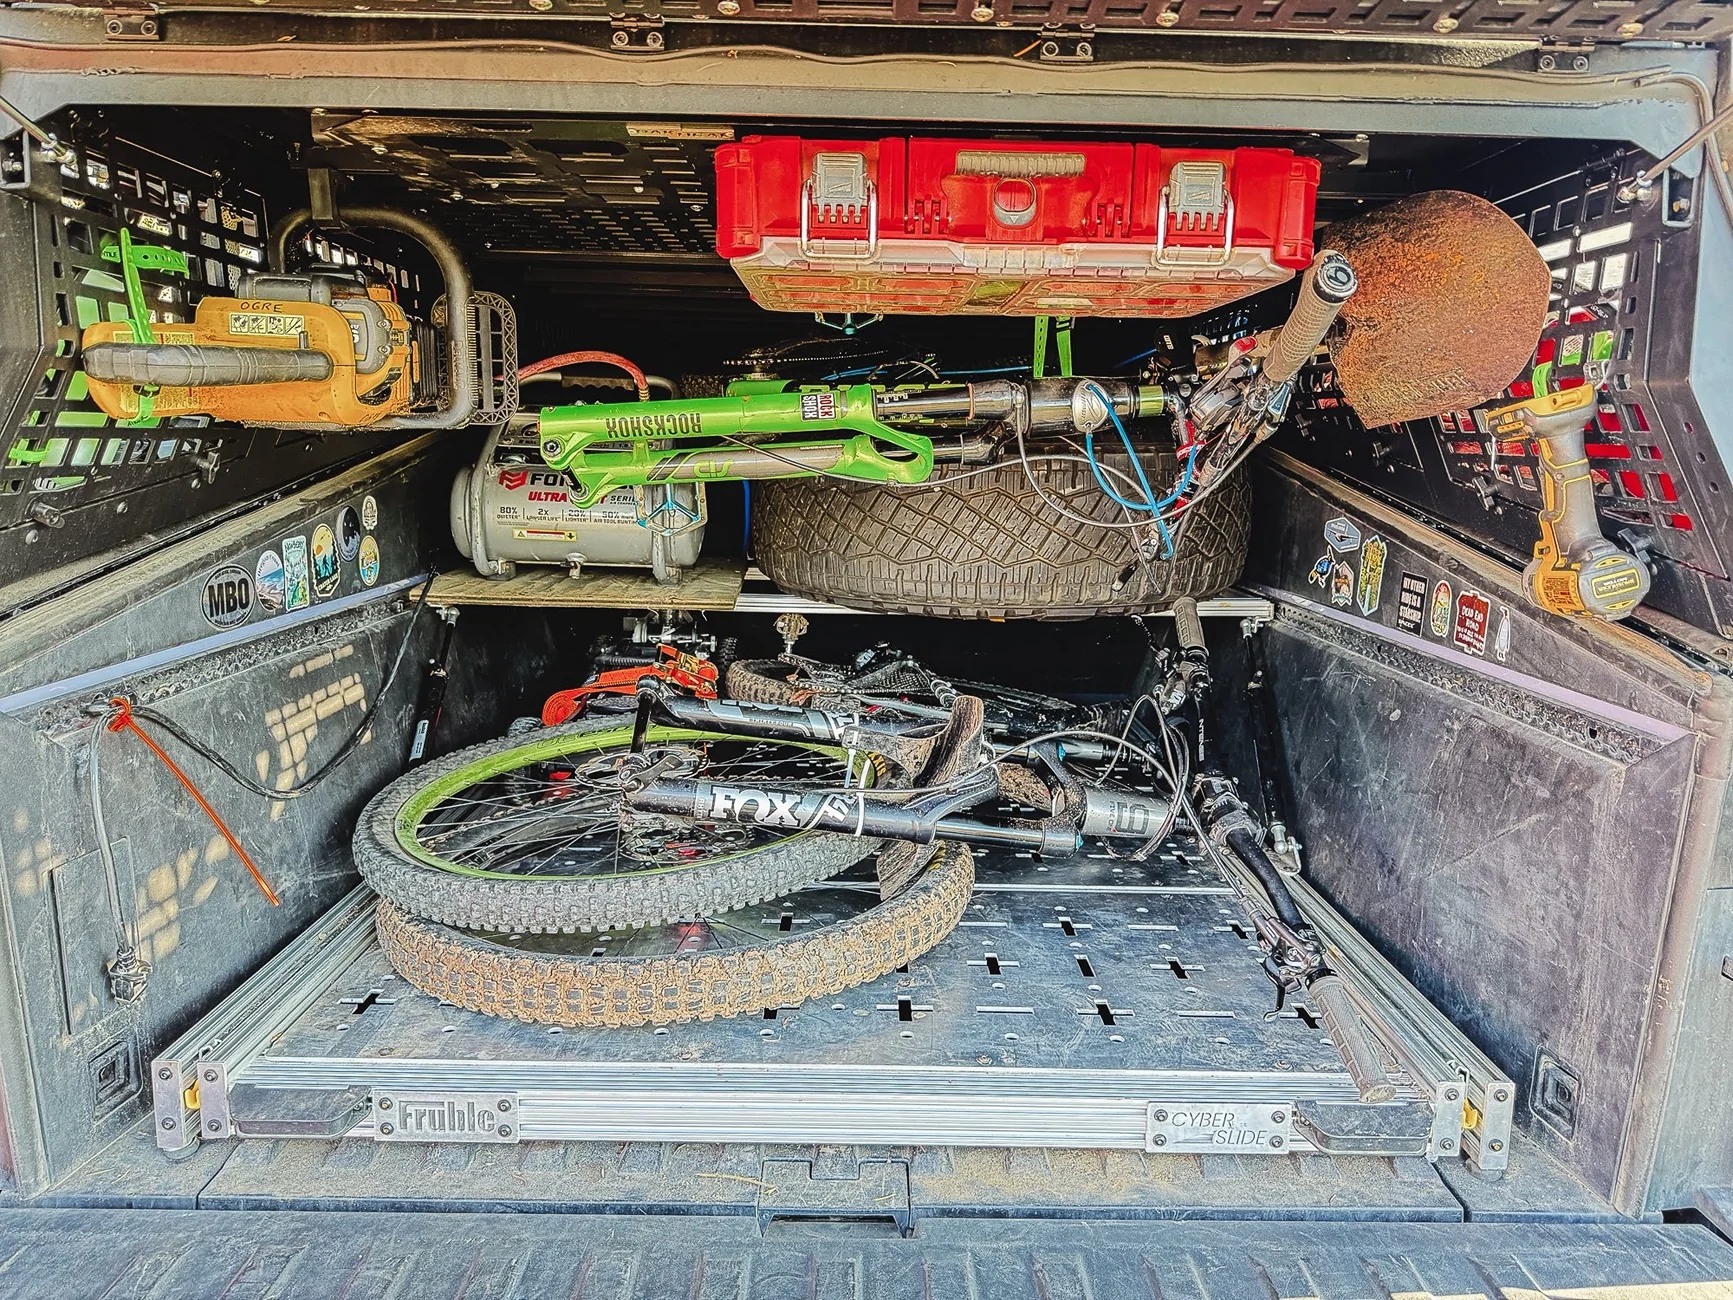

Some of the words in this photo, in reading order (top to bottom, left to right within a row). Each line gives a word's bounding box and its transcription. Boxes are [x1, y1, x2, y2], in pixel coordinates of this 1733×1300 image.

[240, 301, 284, 313] OGRE
[803, 395, 818, 418] SHOX
[819, 394, 834, 418] ROCK
[605, 413, 702, 439] ROCKSHOX
[528, 491, 568, 503] ULTRA
[500, 506, 518, 514] 80%
[208, 577, 250, 618] MBO
[1462, 605, 1474, 618] DEAD
[1474, 609, 1484, 622] END
[869, 751, 888, 777] XXIS
[711, 786, 801, 827] FOX
[1171, 1111, 1234, 1128] CYBER
[1215, 1129, 1267, 1145] SLIDE
